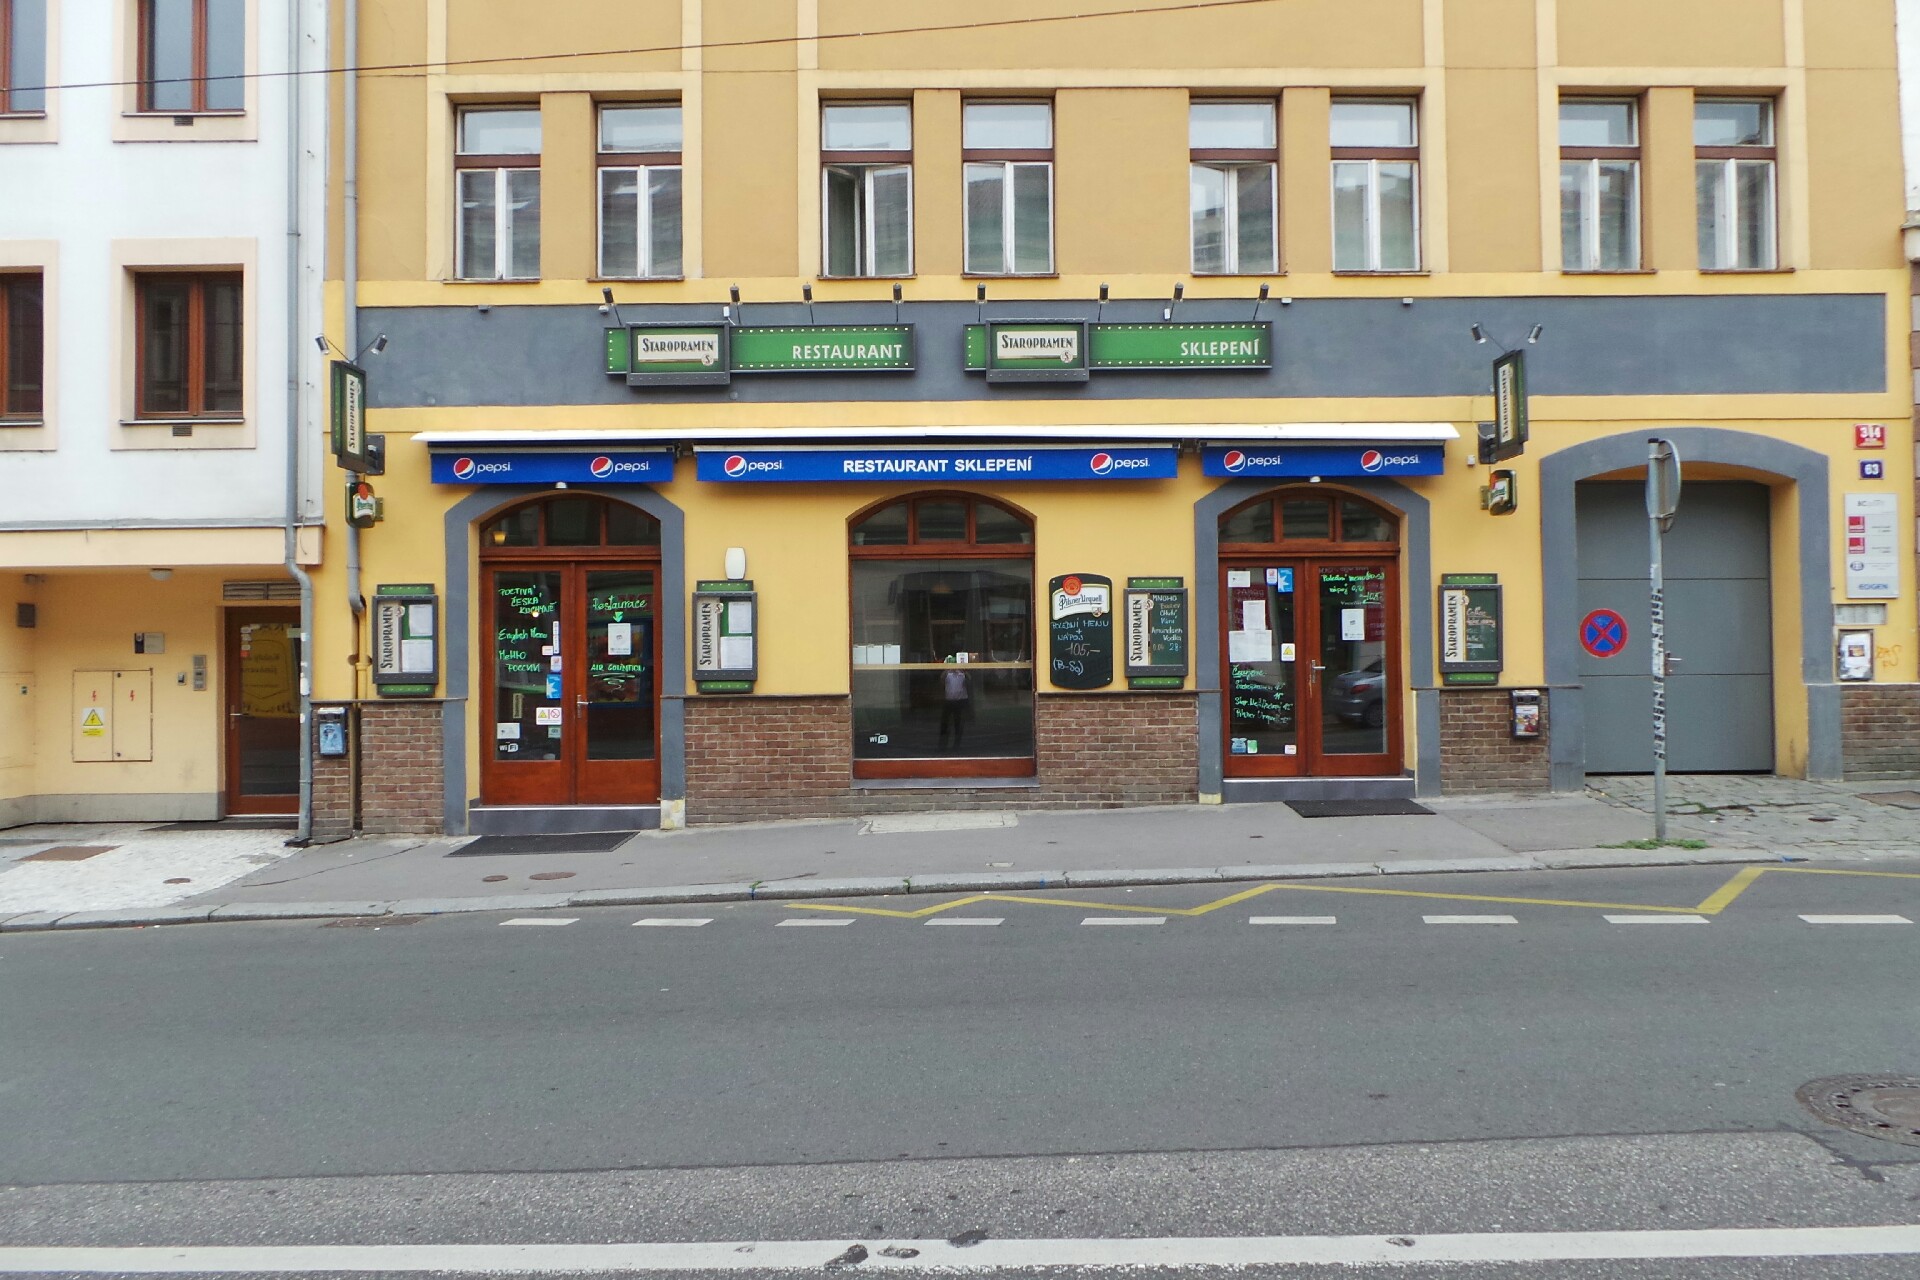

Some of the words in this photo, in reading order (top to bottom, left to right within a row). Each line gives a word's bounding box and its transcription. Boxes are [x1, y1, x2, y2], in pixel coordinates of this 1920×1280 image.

[642, 337, 714, 354] STAROPRAMEN
[1001, 334, 1073, 351] STAROPRAMEN
[1180, 338, 1260, 356] SKLEPENÍ
[793, 345, 902, 360] RESTAURANT
[477, 461, 511, 475] pepsi
[614, 460, 649, 473] pepsi
[748, 459, 783, 473] pepsi
[843, 459, 948, 473] RESTAURANT
[954, 456, 1033, 472] SKLEPENÍ
[1114, 457, 1149, 470] pepsi
[1247, 455, 1281, 468] pepsi
[1384, 454, 1419, 467] pepsi
[592, 595, 647, 611] Restaurace
[699, 602, 712, 665] STAROPRAMEN
[1130, 599, 1142, 662] STAROPRAMEN
[1446, 595, 1457, 657] STAROPRAMEN
[380, 606, 393, 669] STAROPRAMEN
